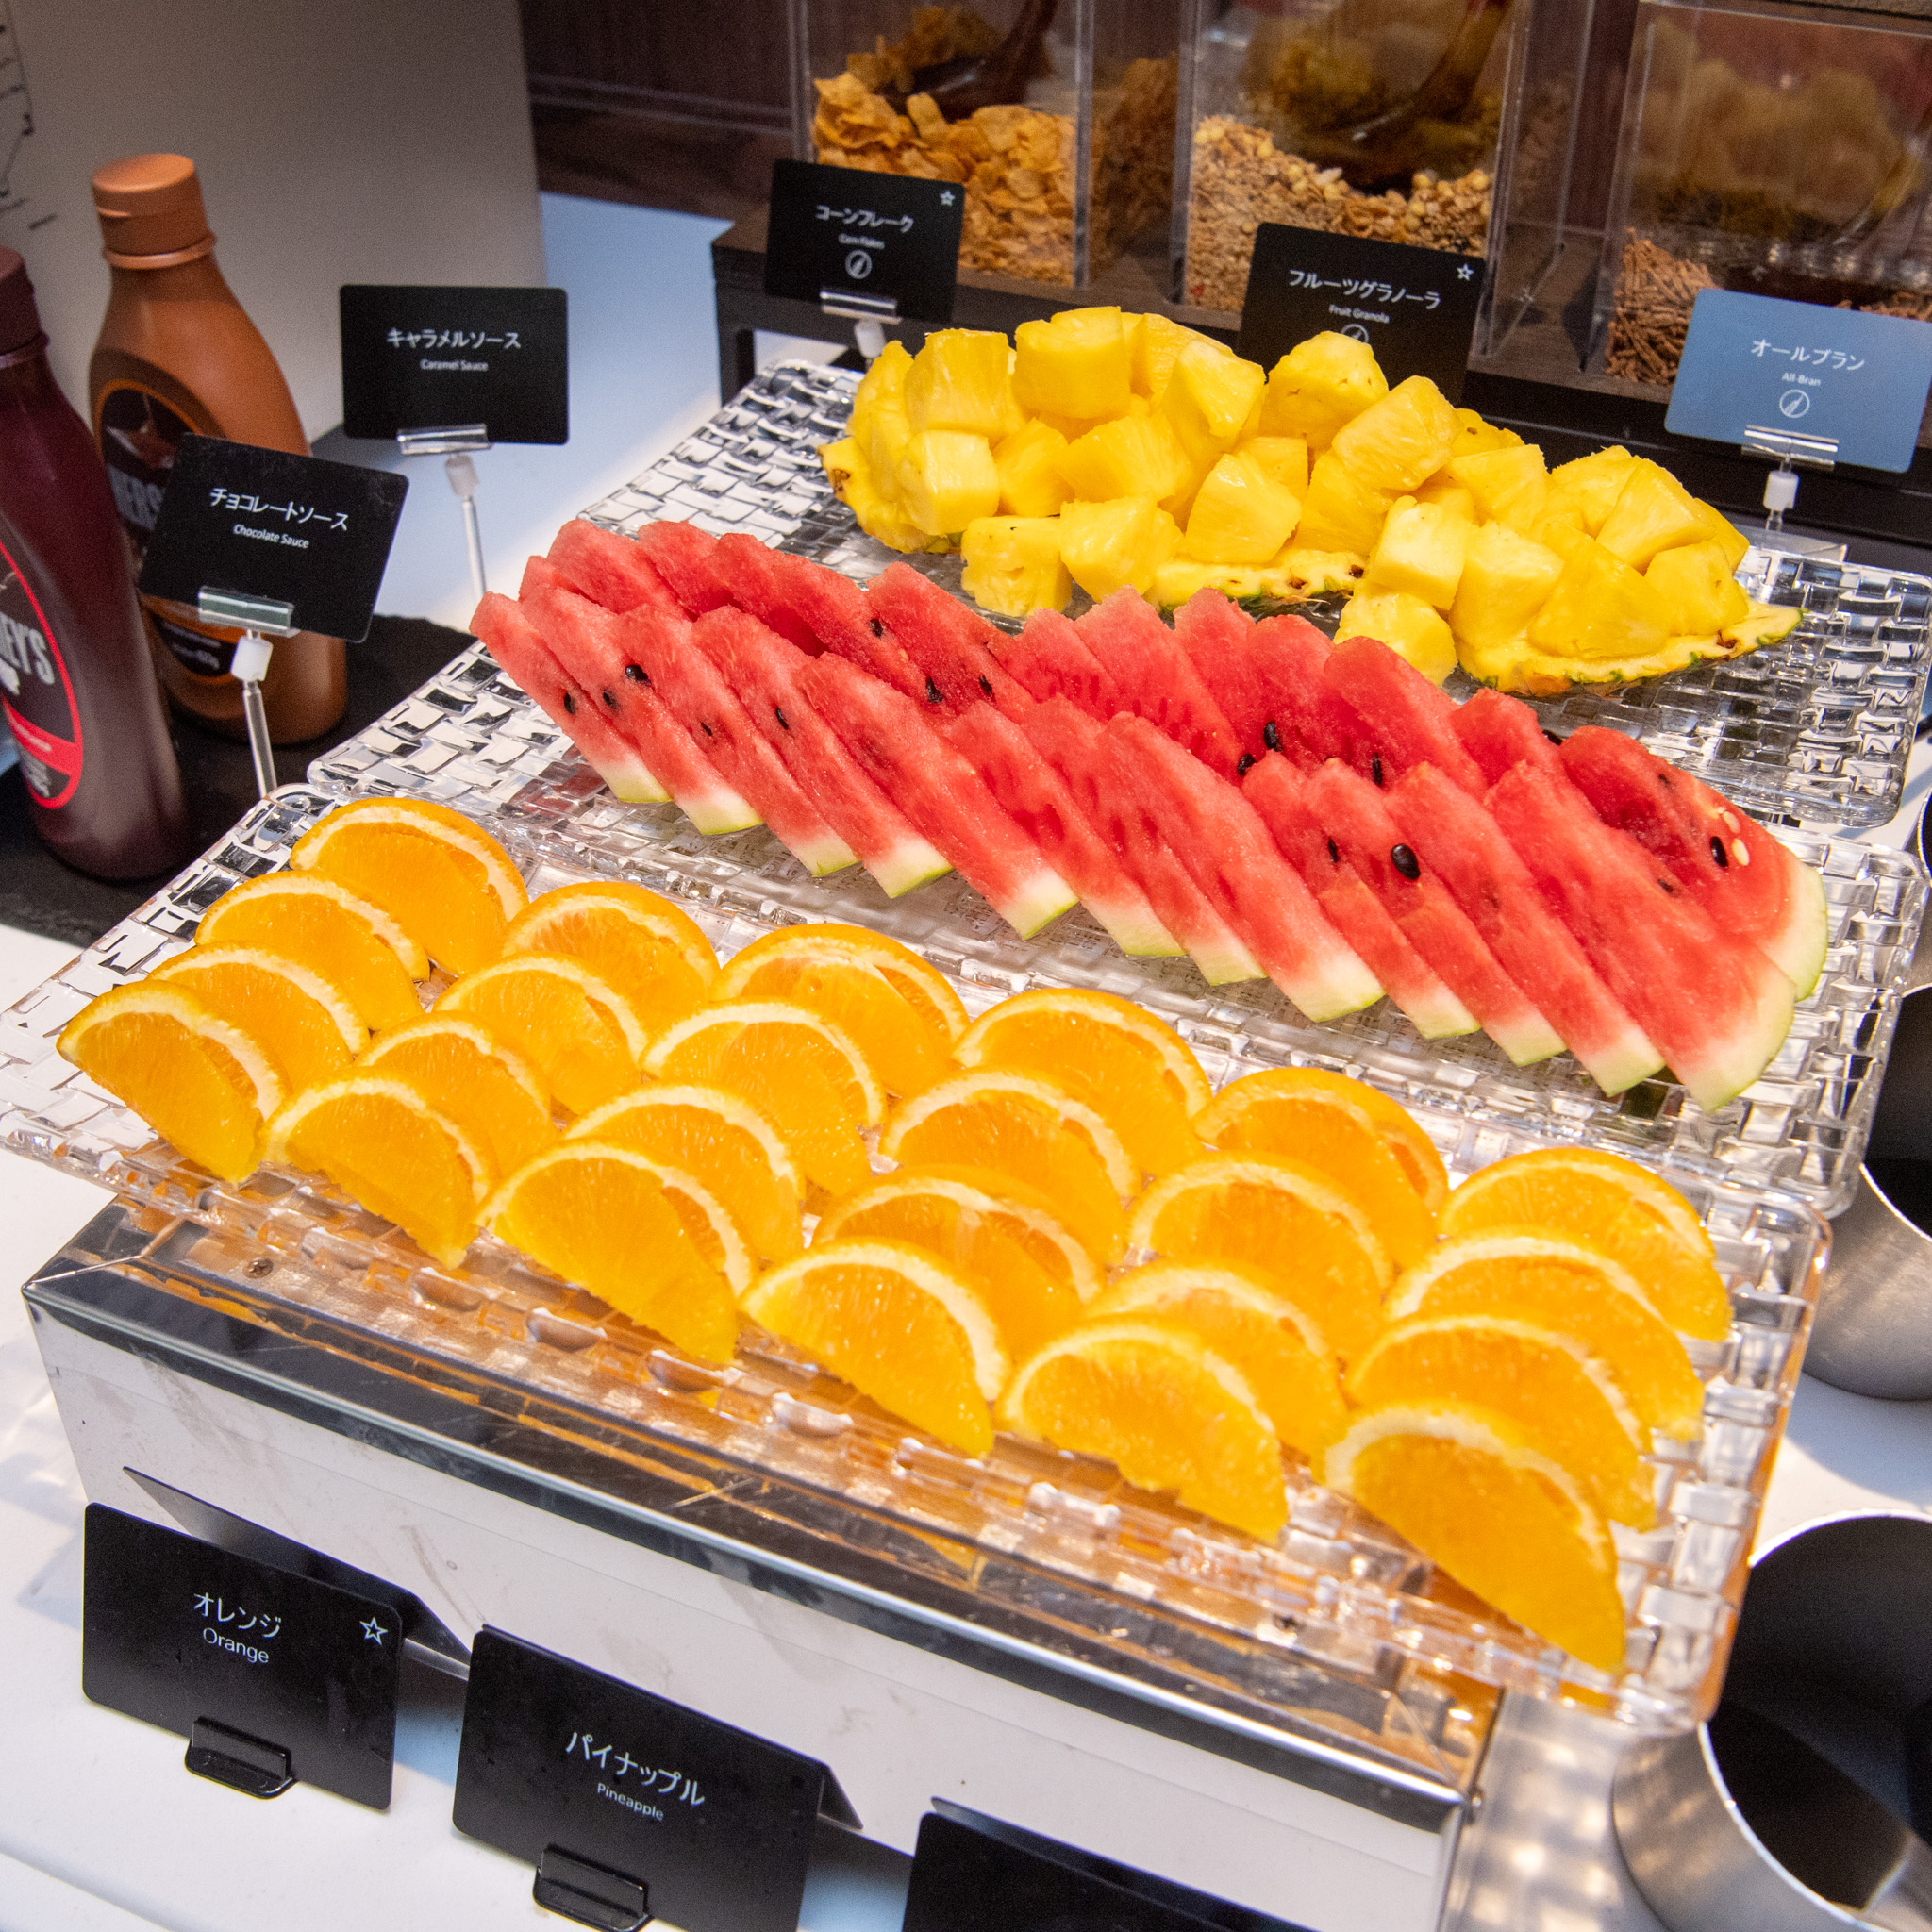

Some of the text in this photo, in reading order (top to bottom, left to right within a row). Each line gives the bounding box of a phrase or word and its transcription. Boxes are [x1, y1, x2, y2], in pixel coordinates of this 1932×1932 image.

[815, 204, 914, 234] コーンフレーク
[1289, 268, 1441, 310] フルーツグラノーラ
[1328, 303, 1391, 324] Fruit Granola
[386, 327, 522, 349] キャラメルソース
[1751, 339, 1865, 371] オールブラン
[420, 358, 489, 372] Caramel Sauce
[209, 487, 349, 531] チョコレートソース
[233, 523, 310, 549] Chocolate Sauce
[193, 1592, 282, 1639] オレンジ
[202, 1627, 270, 1664] Orange
[566, 1732, 706, 1807] パイナップル
[596, 1782, 665, 1822] Pineapple
